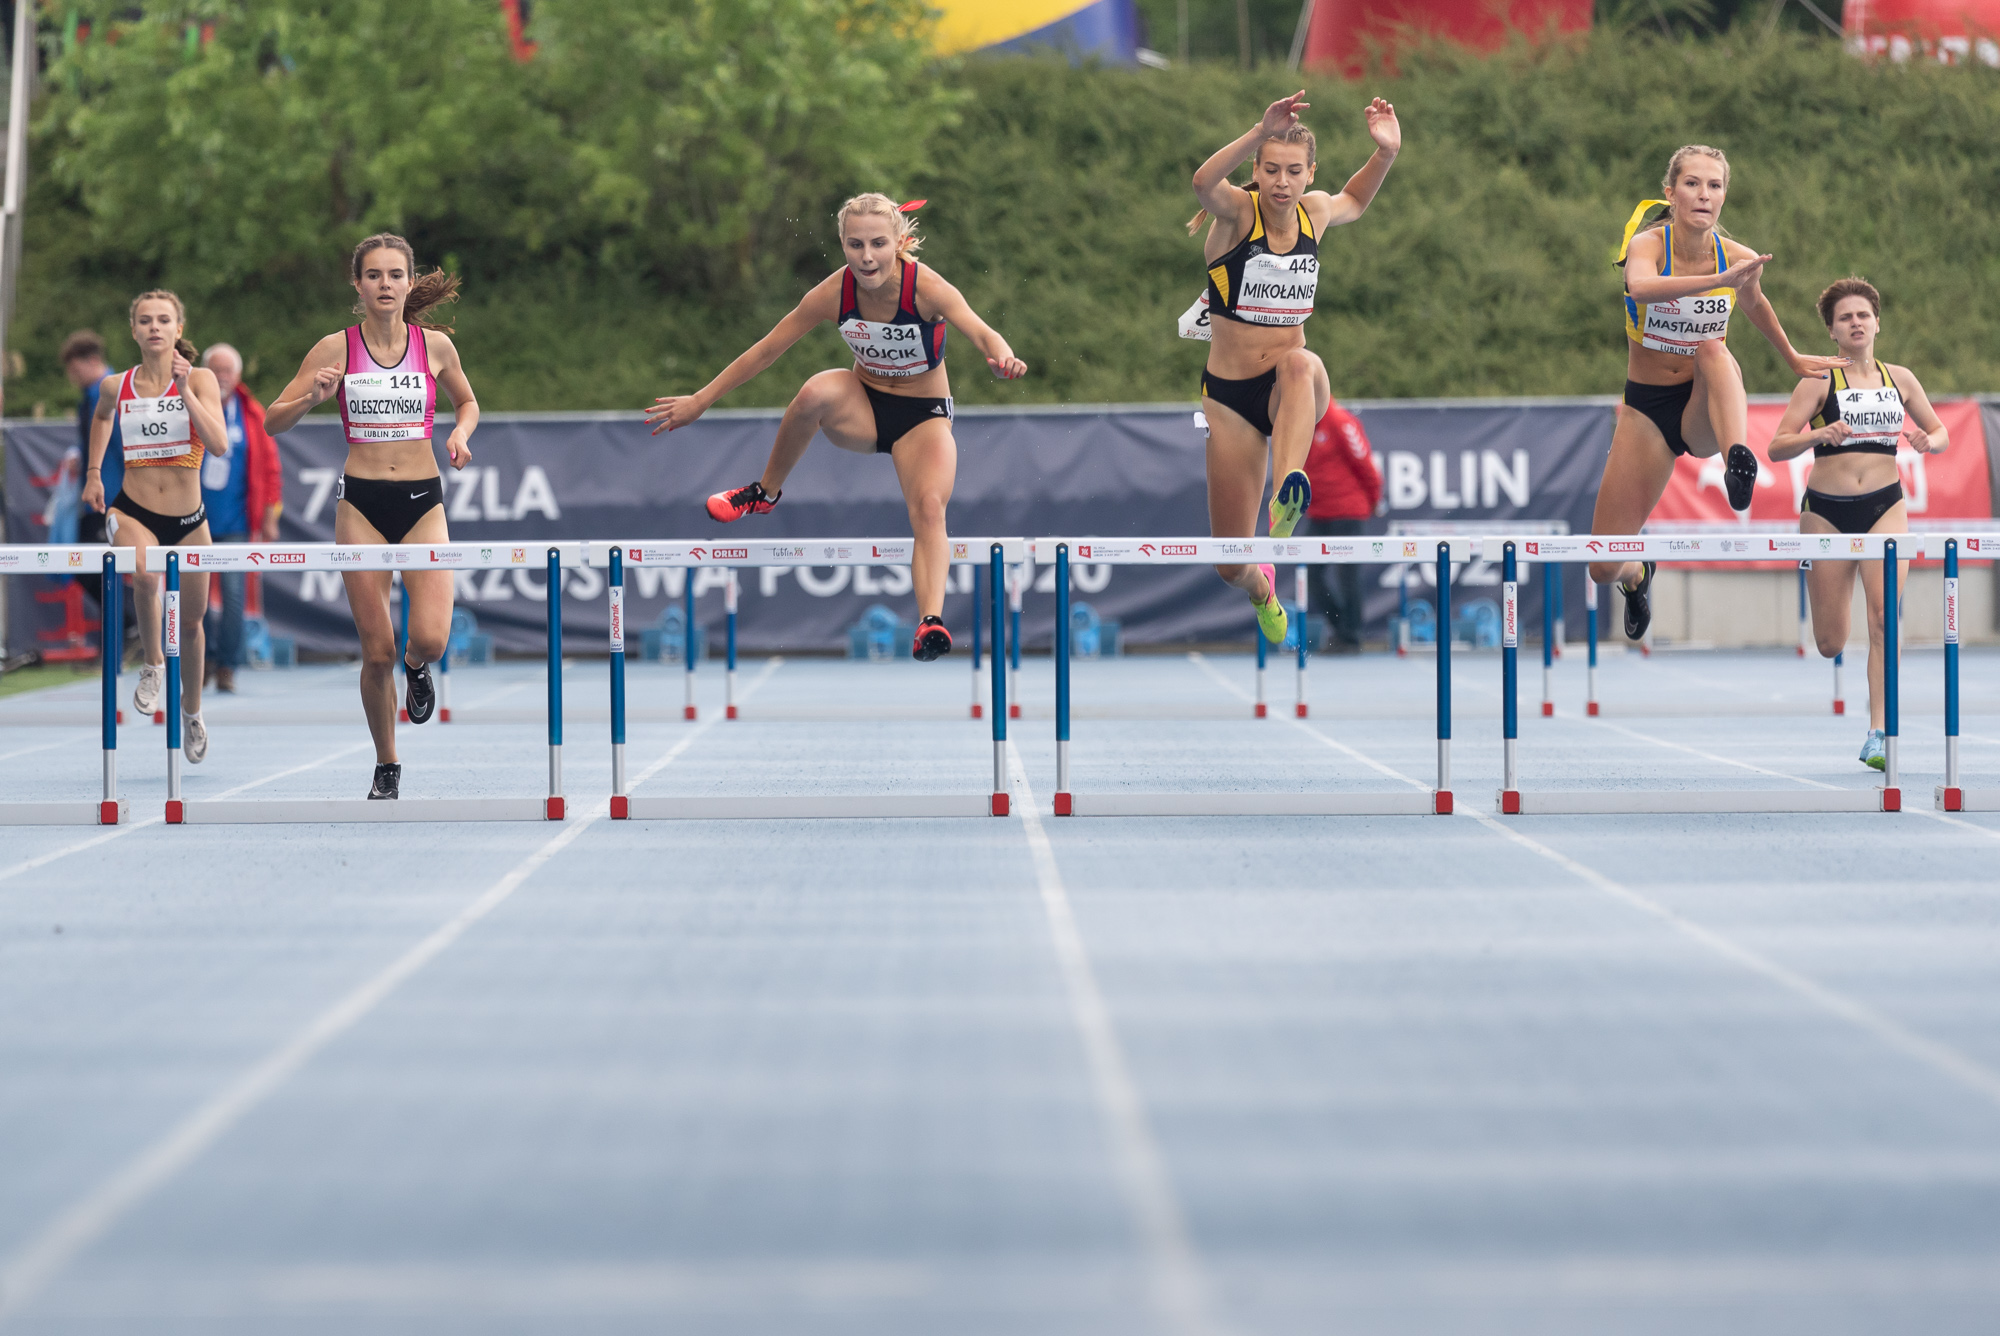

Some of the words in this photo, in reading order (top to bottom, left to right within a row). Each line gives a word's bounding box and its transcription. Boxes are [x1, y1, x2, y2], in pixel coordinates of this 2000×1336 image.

[1288, 258, 1317, 274] 443
[1243, 282, 1315, 300] MIKOŁANIS
[1693, 299, 1727, 314] 338
[1253, 314, 1280, 323] LUBLIN
[1282, 316, 1299, 324] 2021
[1648, 316, 1726, 334] MASTALERZ
[846, 331, 869, 339] ORLEN
[882, 326, 916, 341] 334
[849, 342, 918, 361] WÓJCIK
[1660, 344, 1687, 354] LUBLIN
[390, 375, 422, 389] 141
[156, 398, 185, 412] 563
[349, 396, 422, 414] OLESZCZYŃSKA
[1844, 410, 1903, 426] ŚMIETANKA
[141, 422, 168, 436] ŁOS
[392, 430, 409, 438] 2021
[137, 450, 160, 458] LUBLIN
[161, 448, 176, 456] 2021
[1372, 449, 1531, 510] BLIN
[443, 465, 562, 522] ZLA
[180, 514, 201, 526] NIKE
[714, 550, 746, 558] ORLEN
[1163, 546, 1195, 554] ORLEN
[1610, 543, 1642, 552] ORLEN
[272, 554, 303, 562] ORLEN
[1506, 598, 1516, 635] polanik
[1946, 594, 1956, 632] polanik
[168, 608, 176, 644] polanik
[611, 603, 621, 640] polanik
